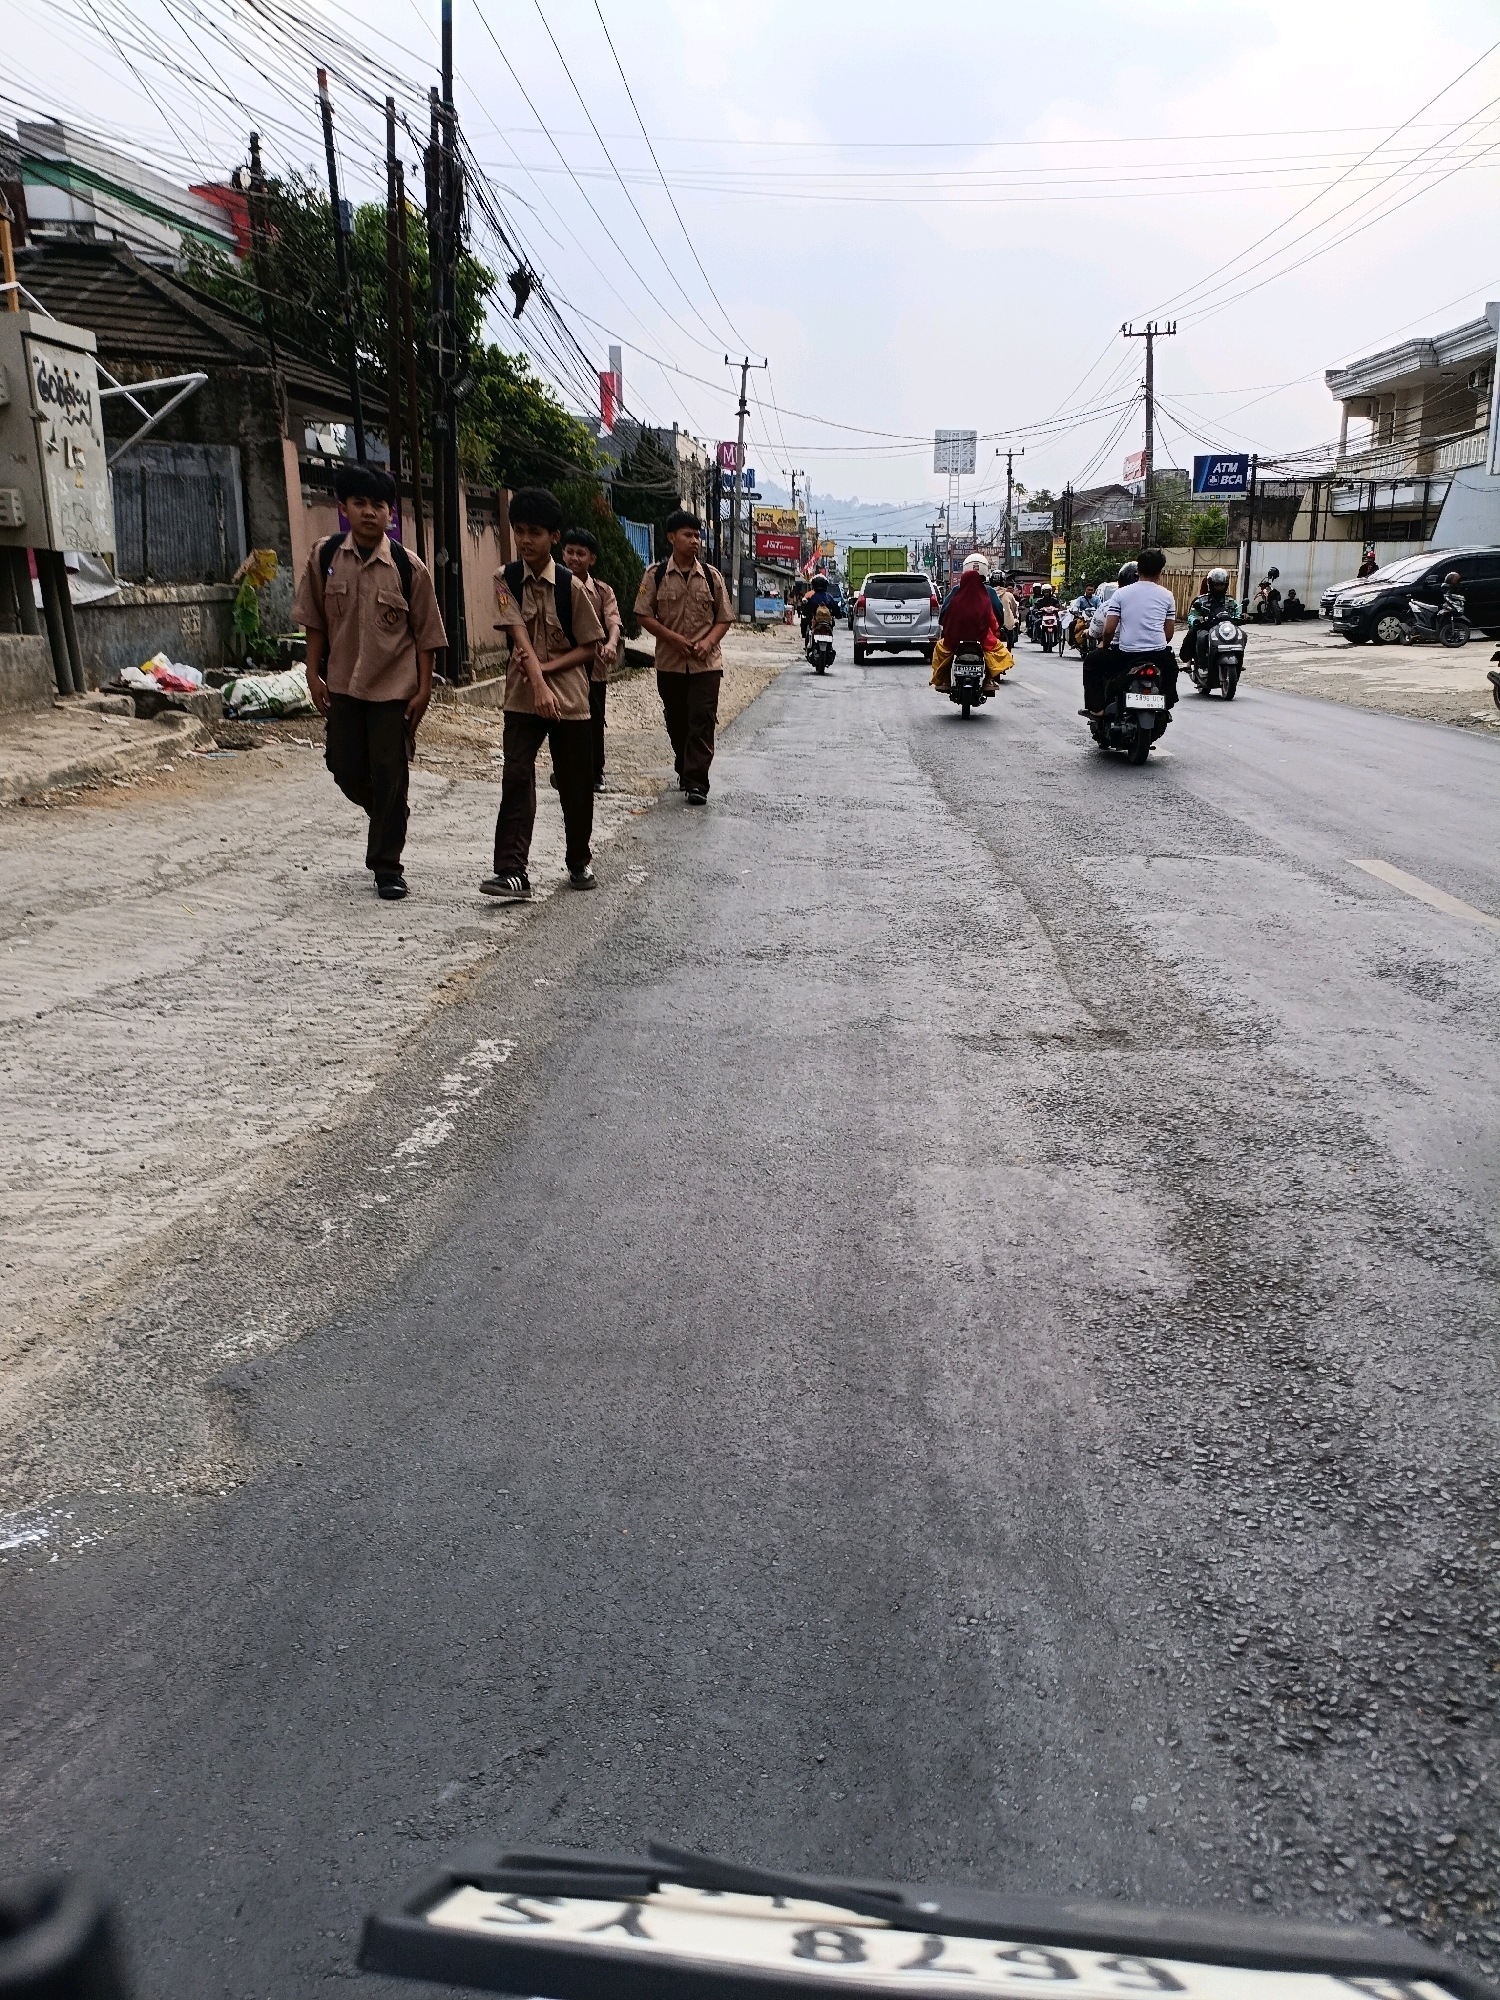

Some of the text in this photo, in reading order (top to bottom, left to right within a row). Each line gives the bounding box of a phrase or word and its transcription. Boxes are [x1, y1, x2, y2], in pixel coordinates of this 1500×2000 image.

[1213, 462, 1239, 473] ATM
[1220, 474, 1243, 485] BCA
[762, 540, 783, 550] J&T
[791, 1925, 1187, 1991] 6678
